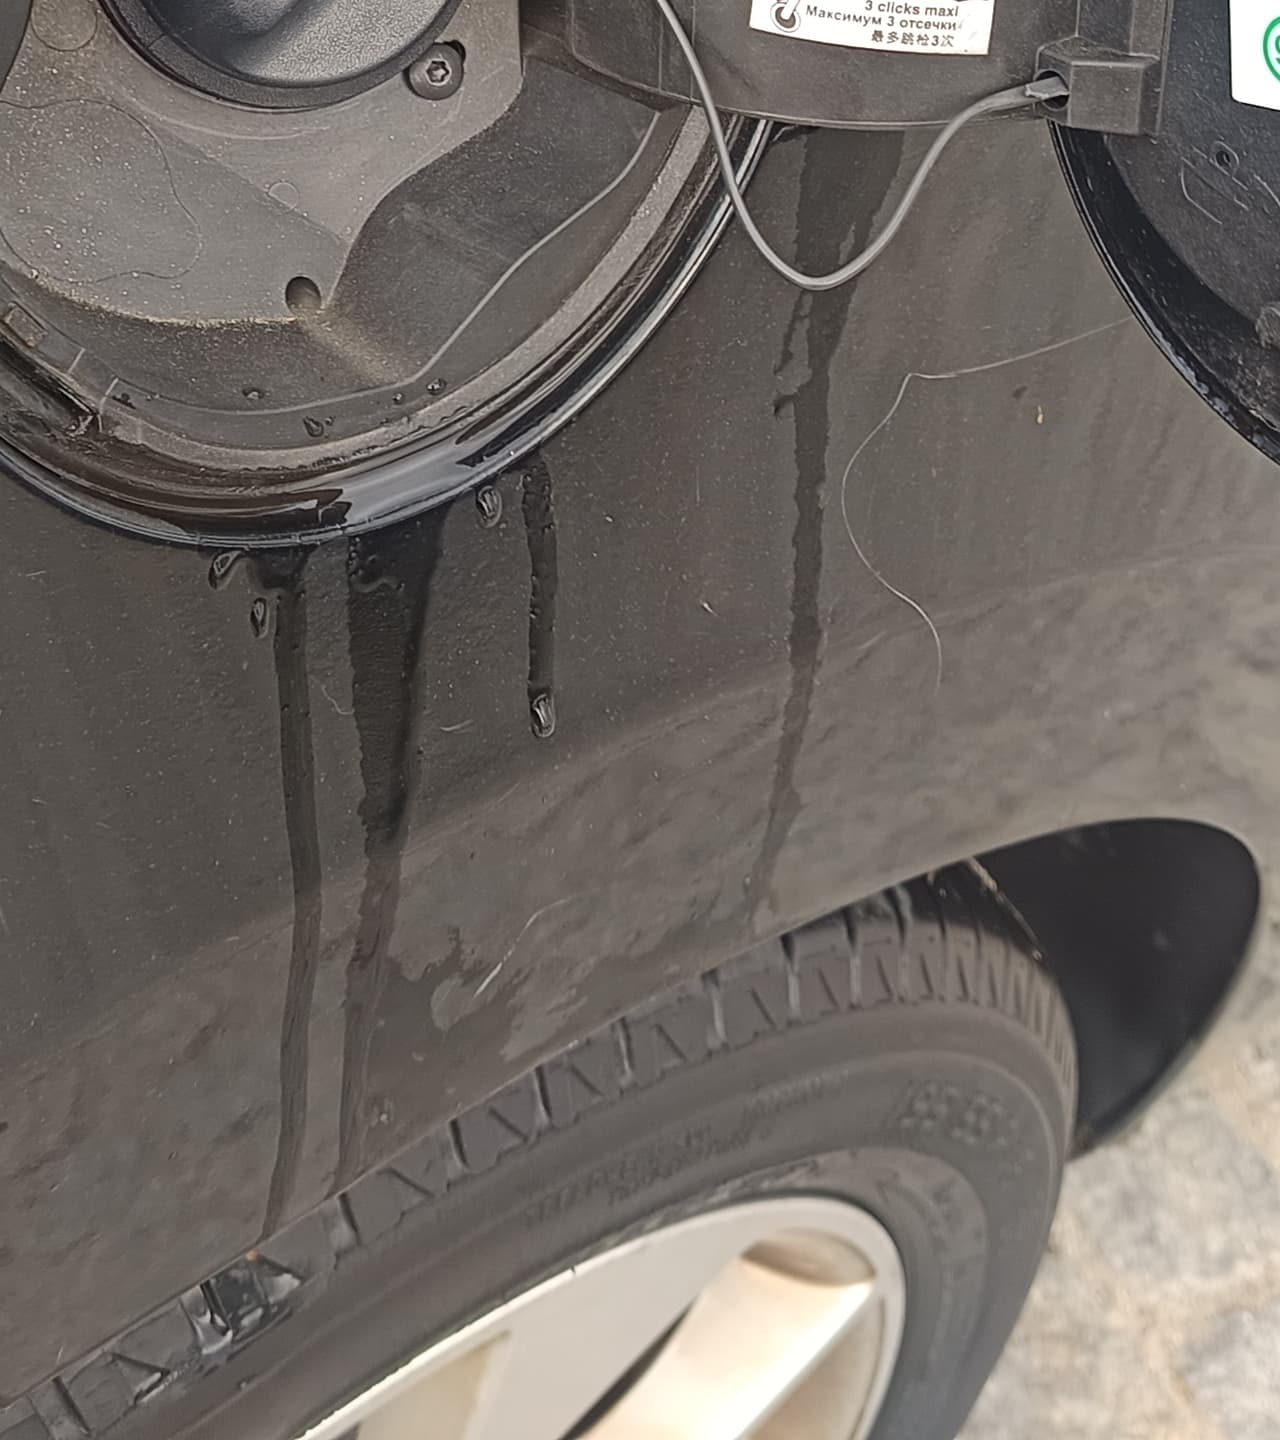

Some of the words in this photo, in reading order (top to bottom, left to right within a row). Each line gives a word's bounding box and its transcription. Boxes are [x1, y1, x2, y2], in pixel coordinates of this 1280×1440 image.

[805, 4, 882, 27] Максимум
[886, 16, 895, 27] 3
[899, 17, 957, 32] отсечки
[865, 0, 873, 11] 3
[877, 1, 920, 15] clicks
[924, 4, 959, 17] maxi
